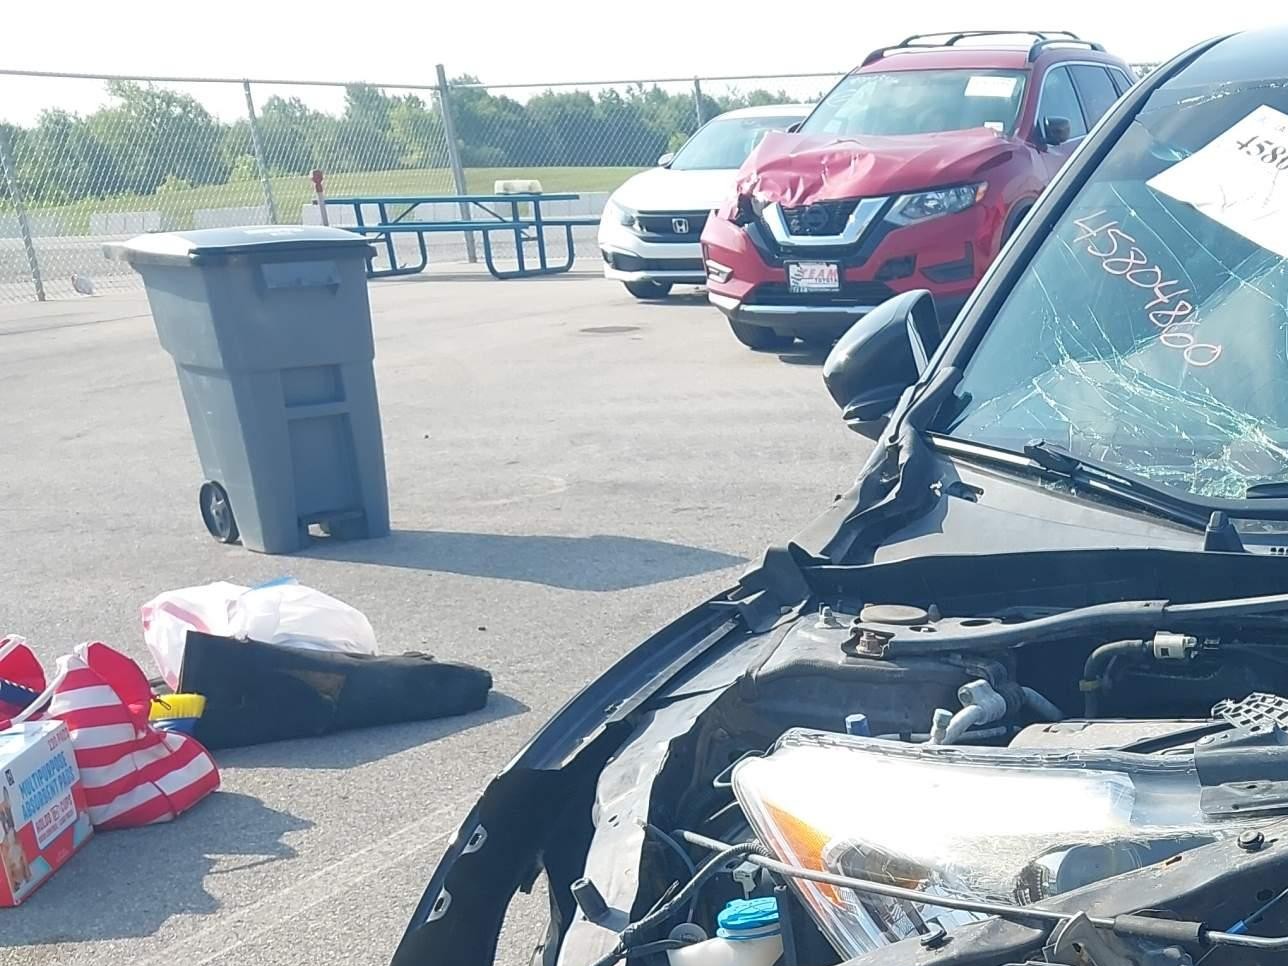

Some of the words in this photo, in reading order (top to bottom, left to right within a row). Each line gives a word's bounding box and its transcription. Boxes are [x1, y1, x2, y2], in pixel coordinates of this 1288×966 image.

[1072, 209, 1222, 367] 45804860
[19, 751, 68, 799] MULTIPURPOSE
[22, 777, 60, 821] ABSORBENT
[57, 766, 75, 790] PADS
